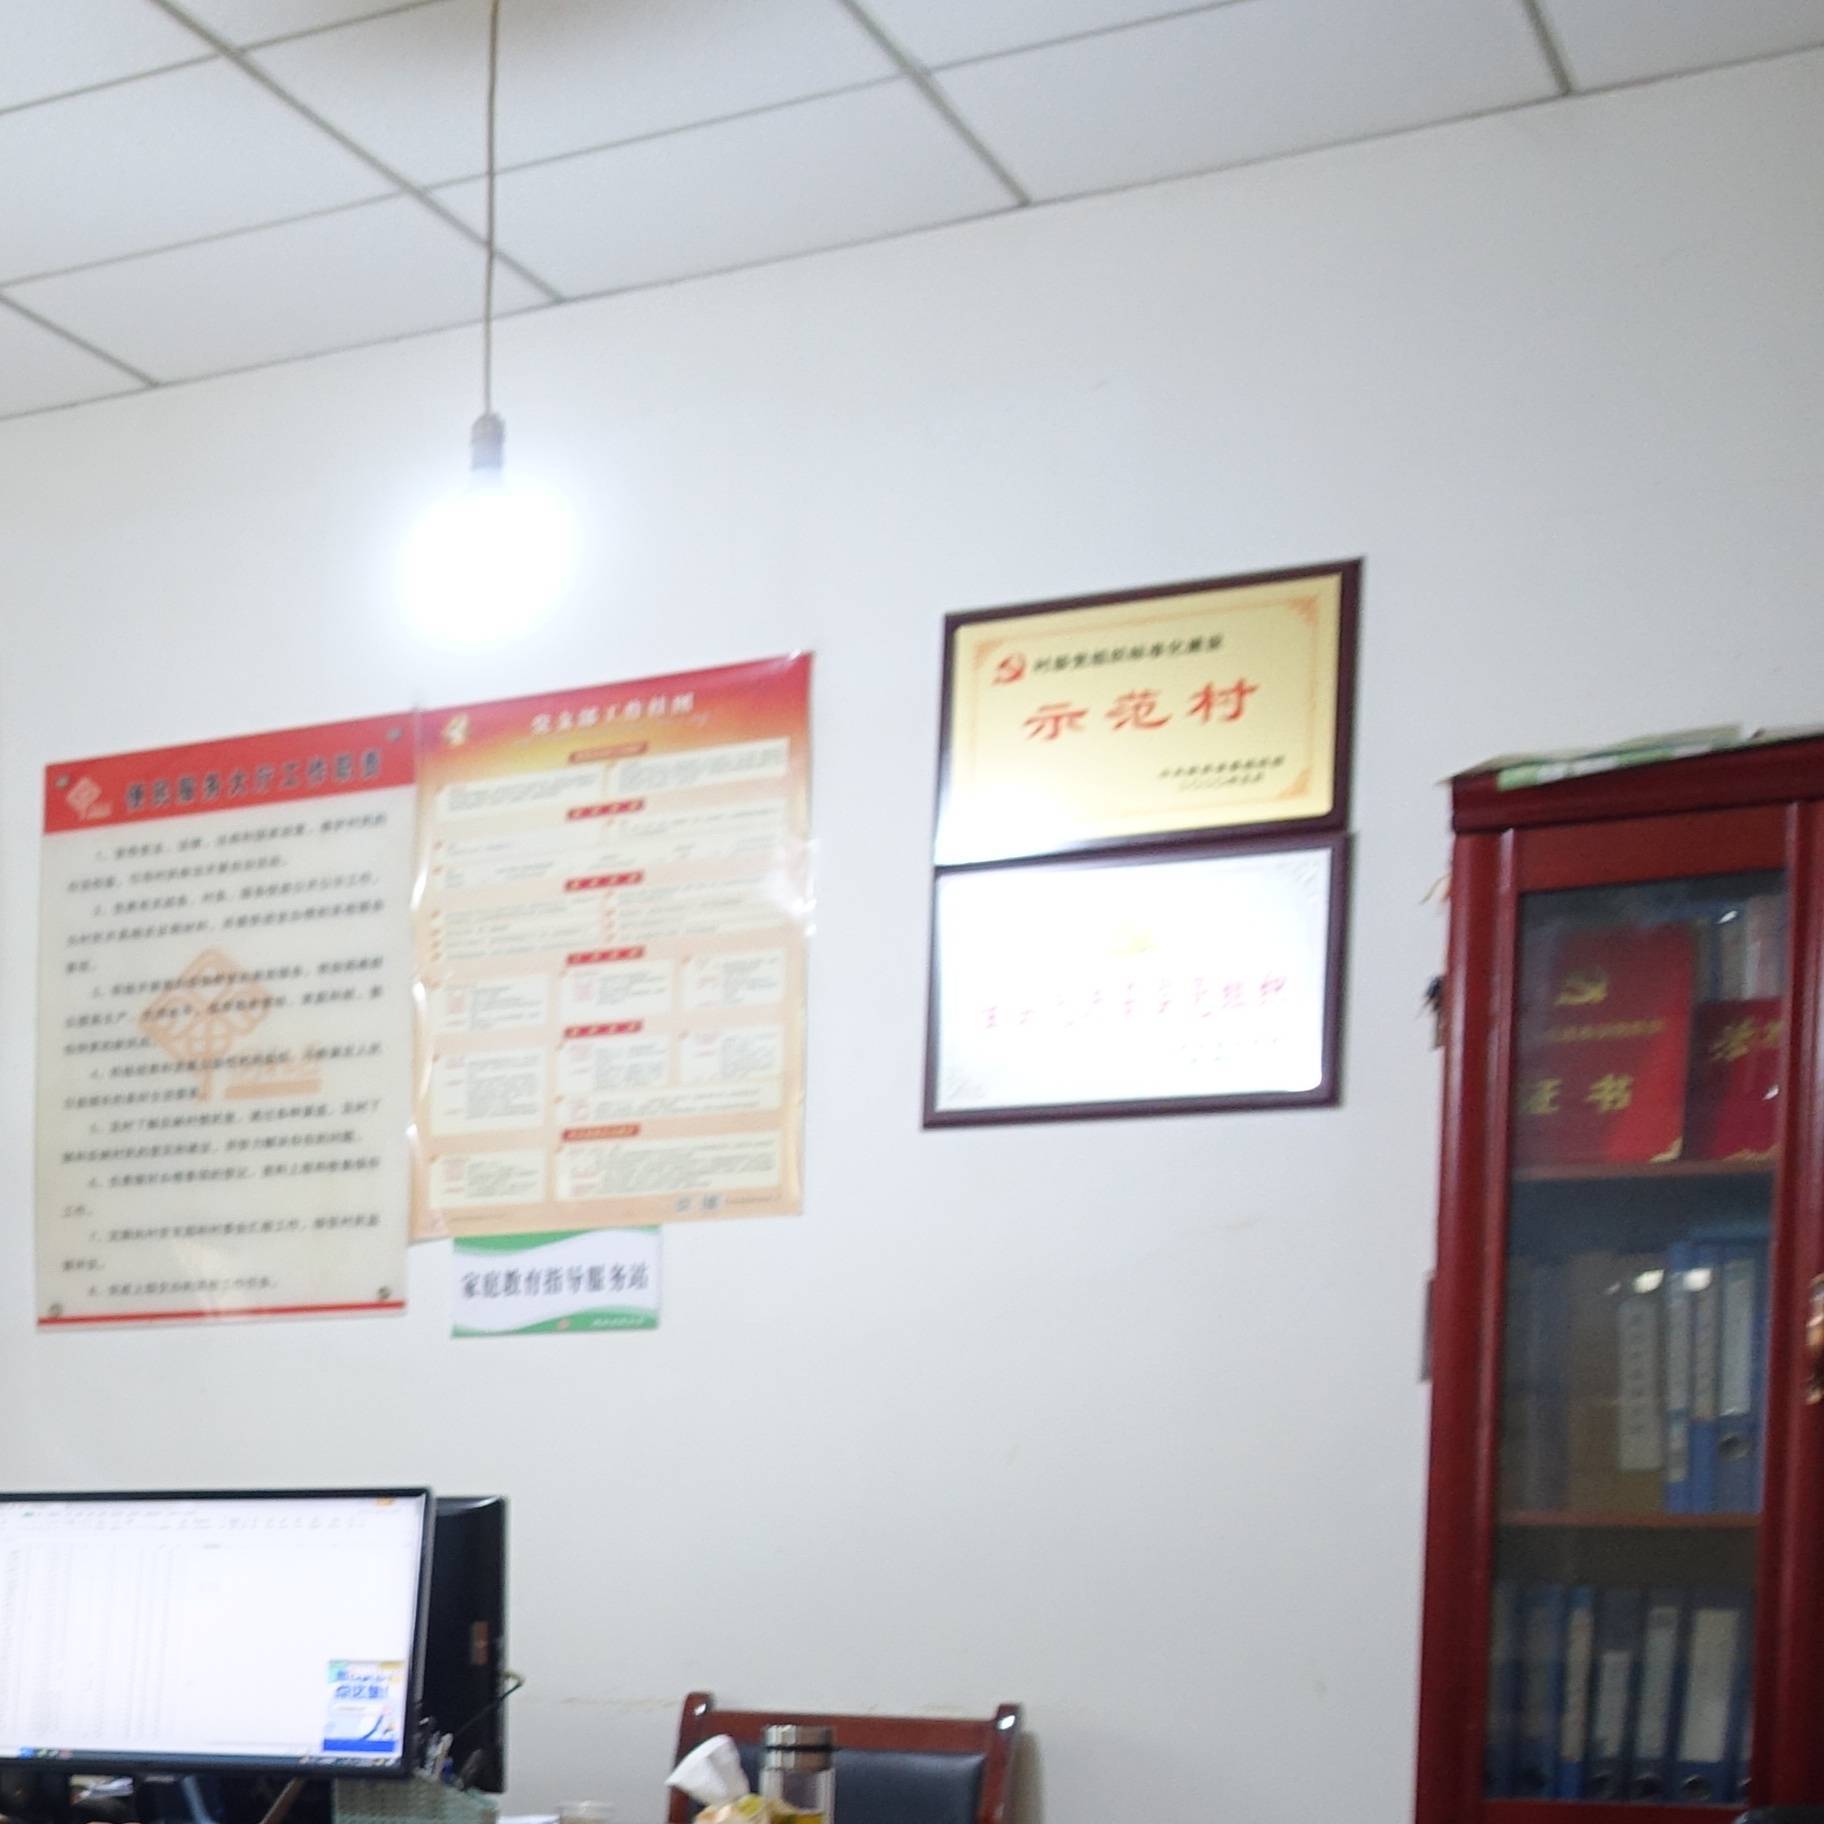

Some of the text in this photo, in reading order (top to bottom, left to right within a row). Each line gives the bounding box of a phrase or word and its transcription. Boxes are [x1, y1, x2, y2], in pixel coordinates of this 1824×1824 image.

[1021, 676, 1261, 742] 示范村
[461, 1261, 650, 1300] 家庭教育指导服务站
